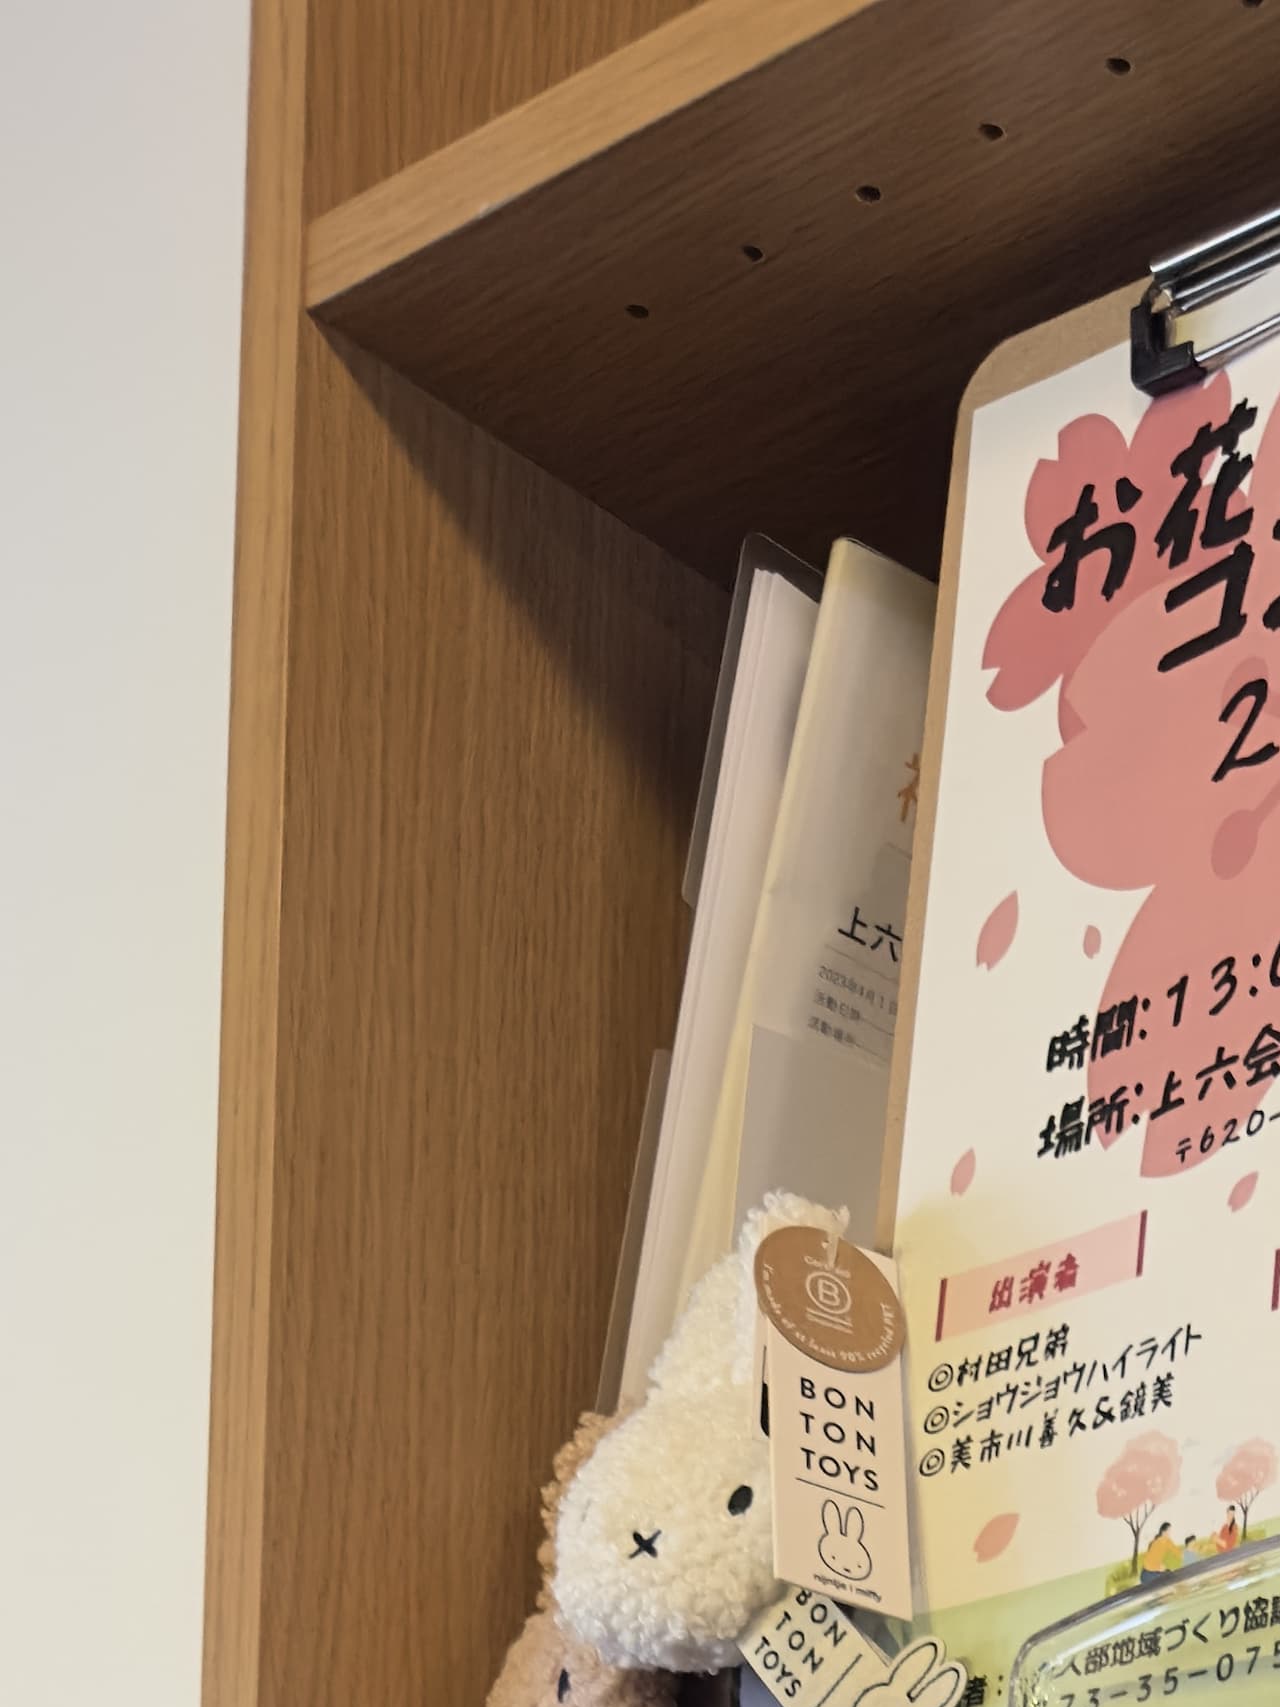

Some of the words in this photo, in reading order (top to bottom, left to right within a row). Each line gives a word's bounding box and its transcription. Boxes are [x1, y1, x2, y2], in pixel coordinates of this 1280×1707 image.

[799, 1377, 876, 1421] BON
[799, 1413, 877, 1458] TON
[801, 1449, 880, 1493] TOYS
[773, 1610, 824, 1672] TON
[754, 1636, 803, 1701] TOYS
